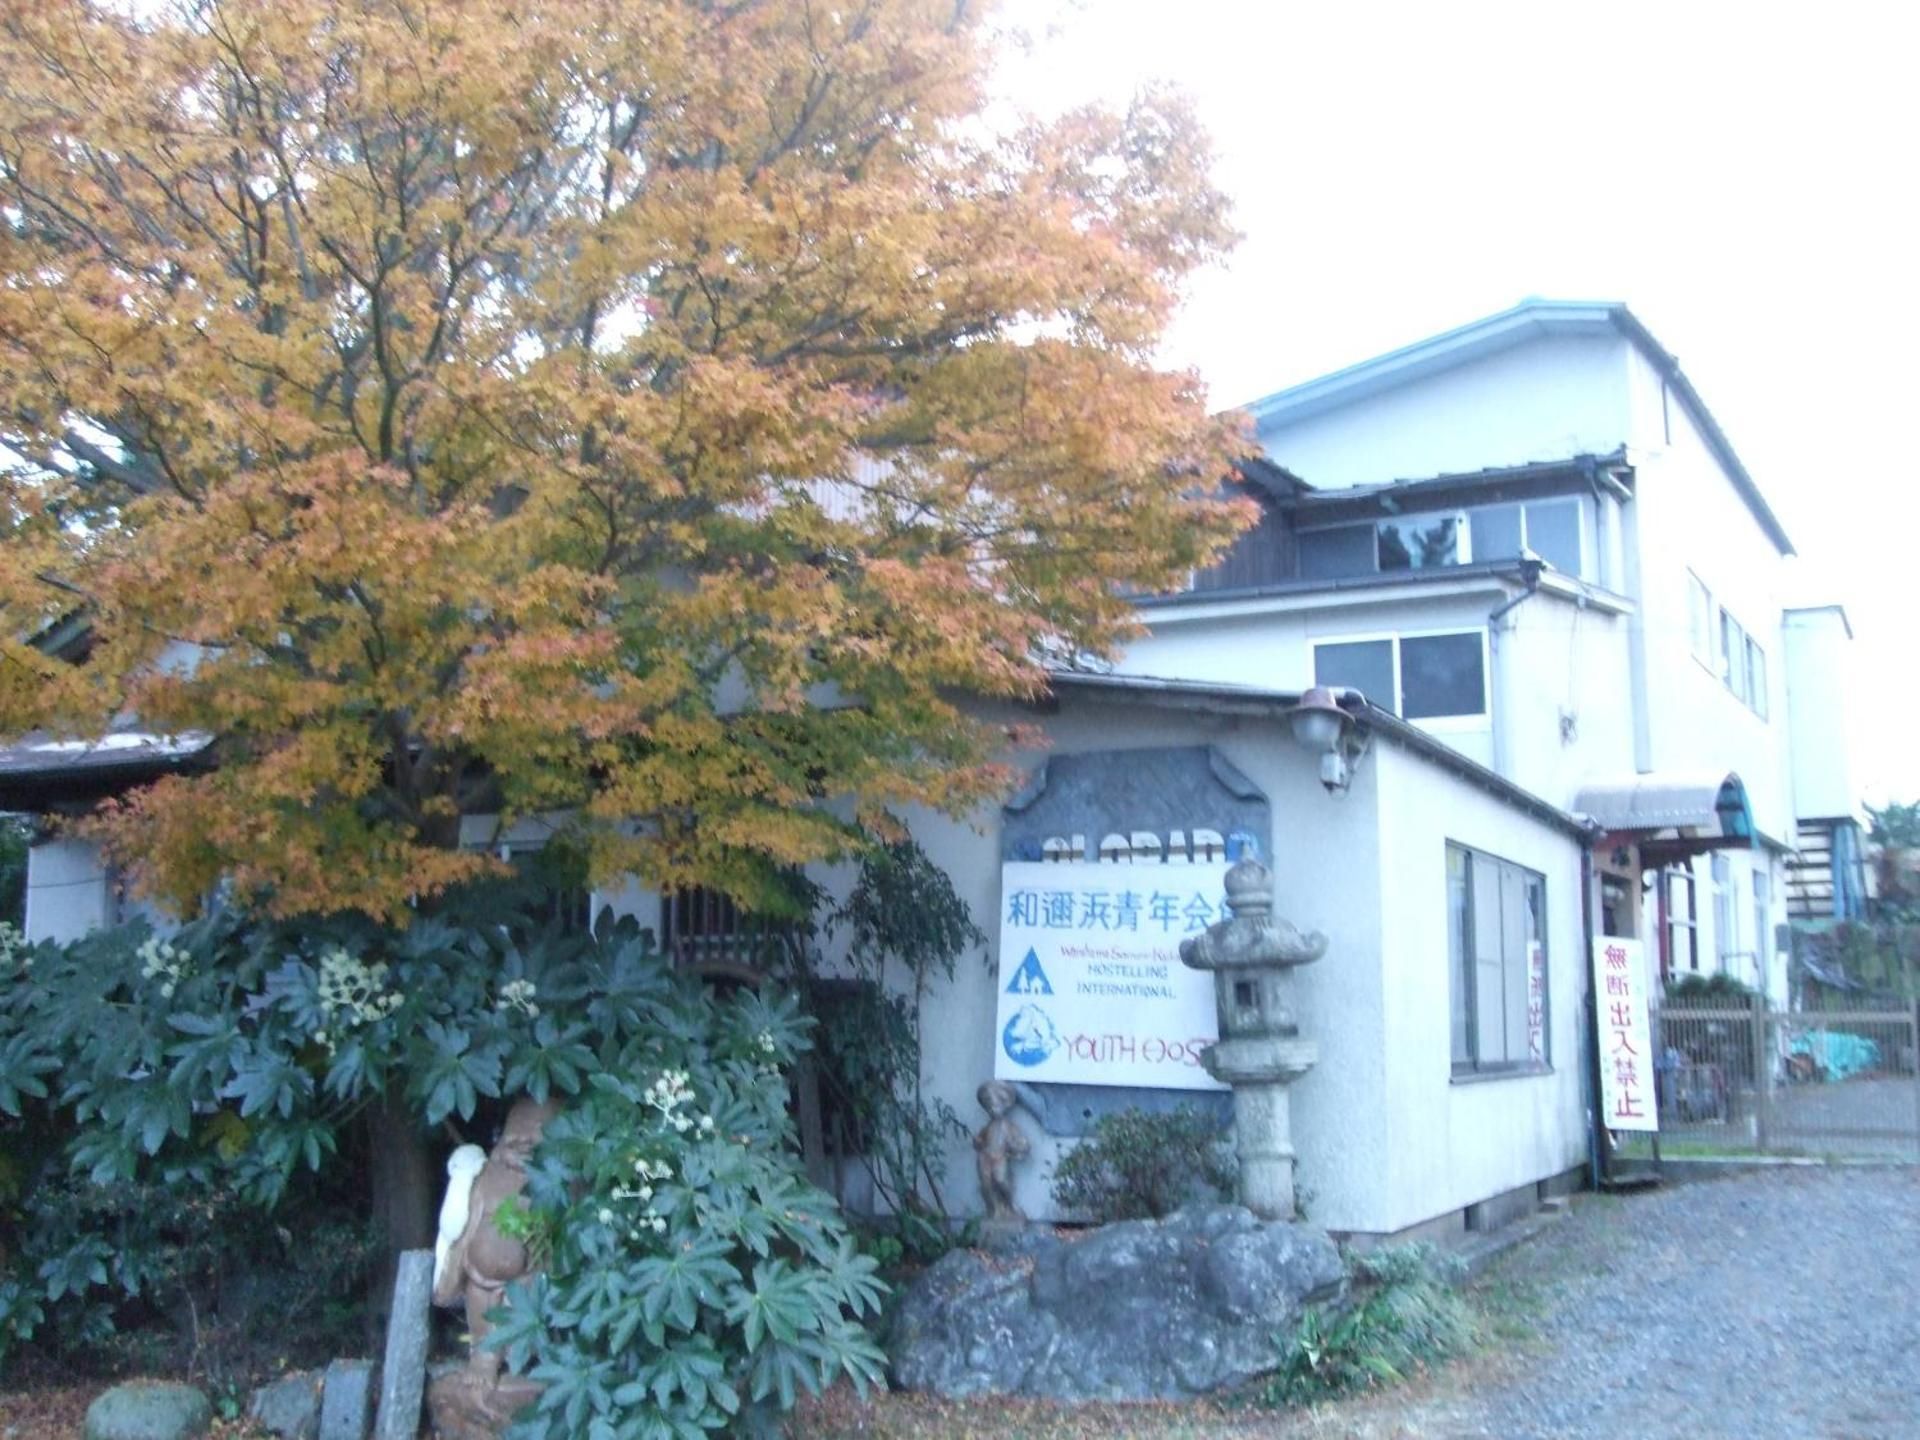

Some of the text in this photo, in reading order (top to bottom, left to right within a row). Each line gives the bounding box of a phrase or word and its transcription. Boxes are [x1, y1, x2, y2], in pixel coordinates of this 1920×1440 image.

[1006, 889, 1238, 933] 和邇浜青年会
[1087, 963, 1168, 979] HOSTELLING
[1077, 982, 1176, 998] INTERNATIONAL
[1604, 945, 1645, 1117] 無断出入禁止
[1063, 1034, 1135, 1063] YOUTH
